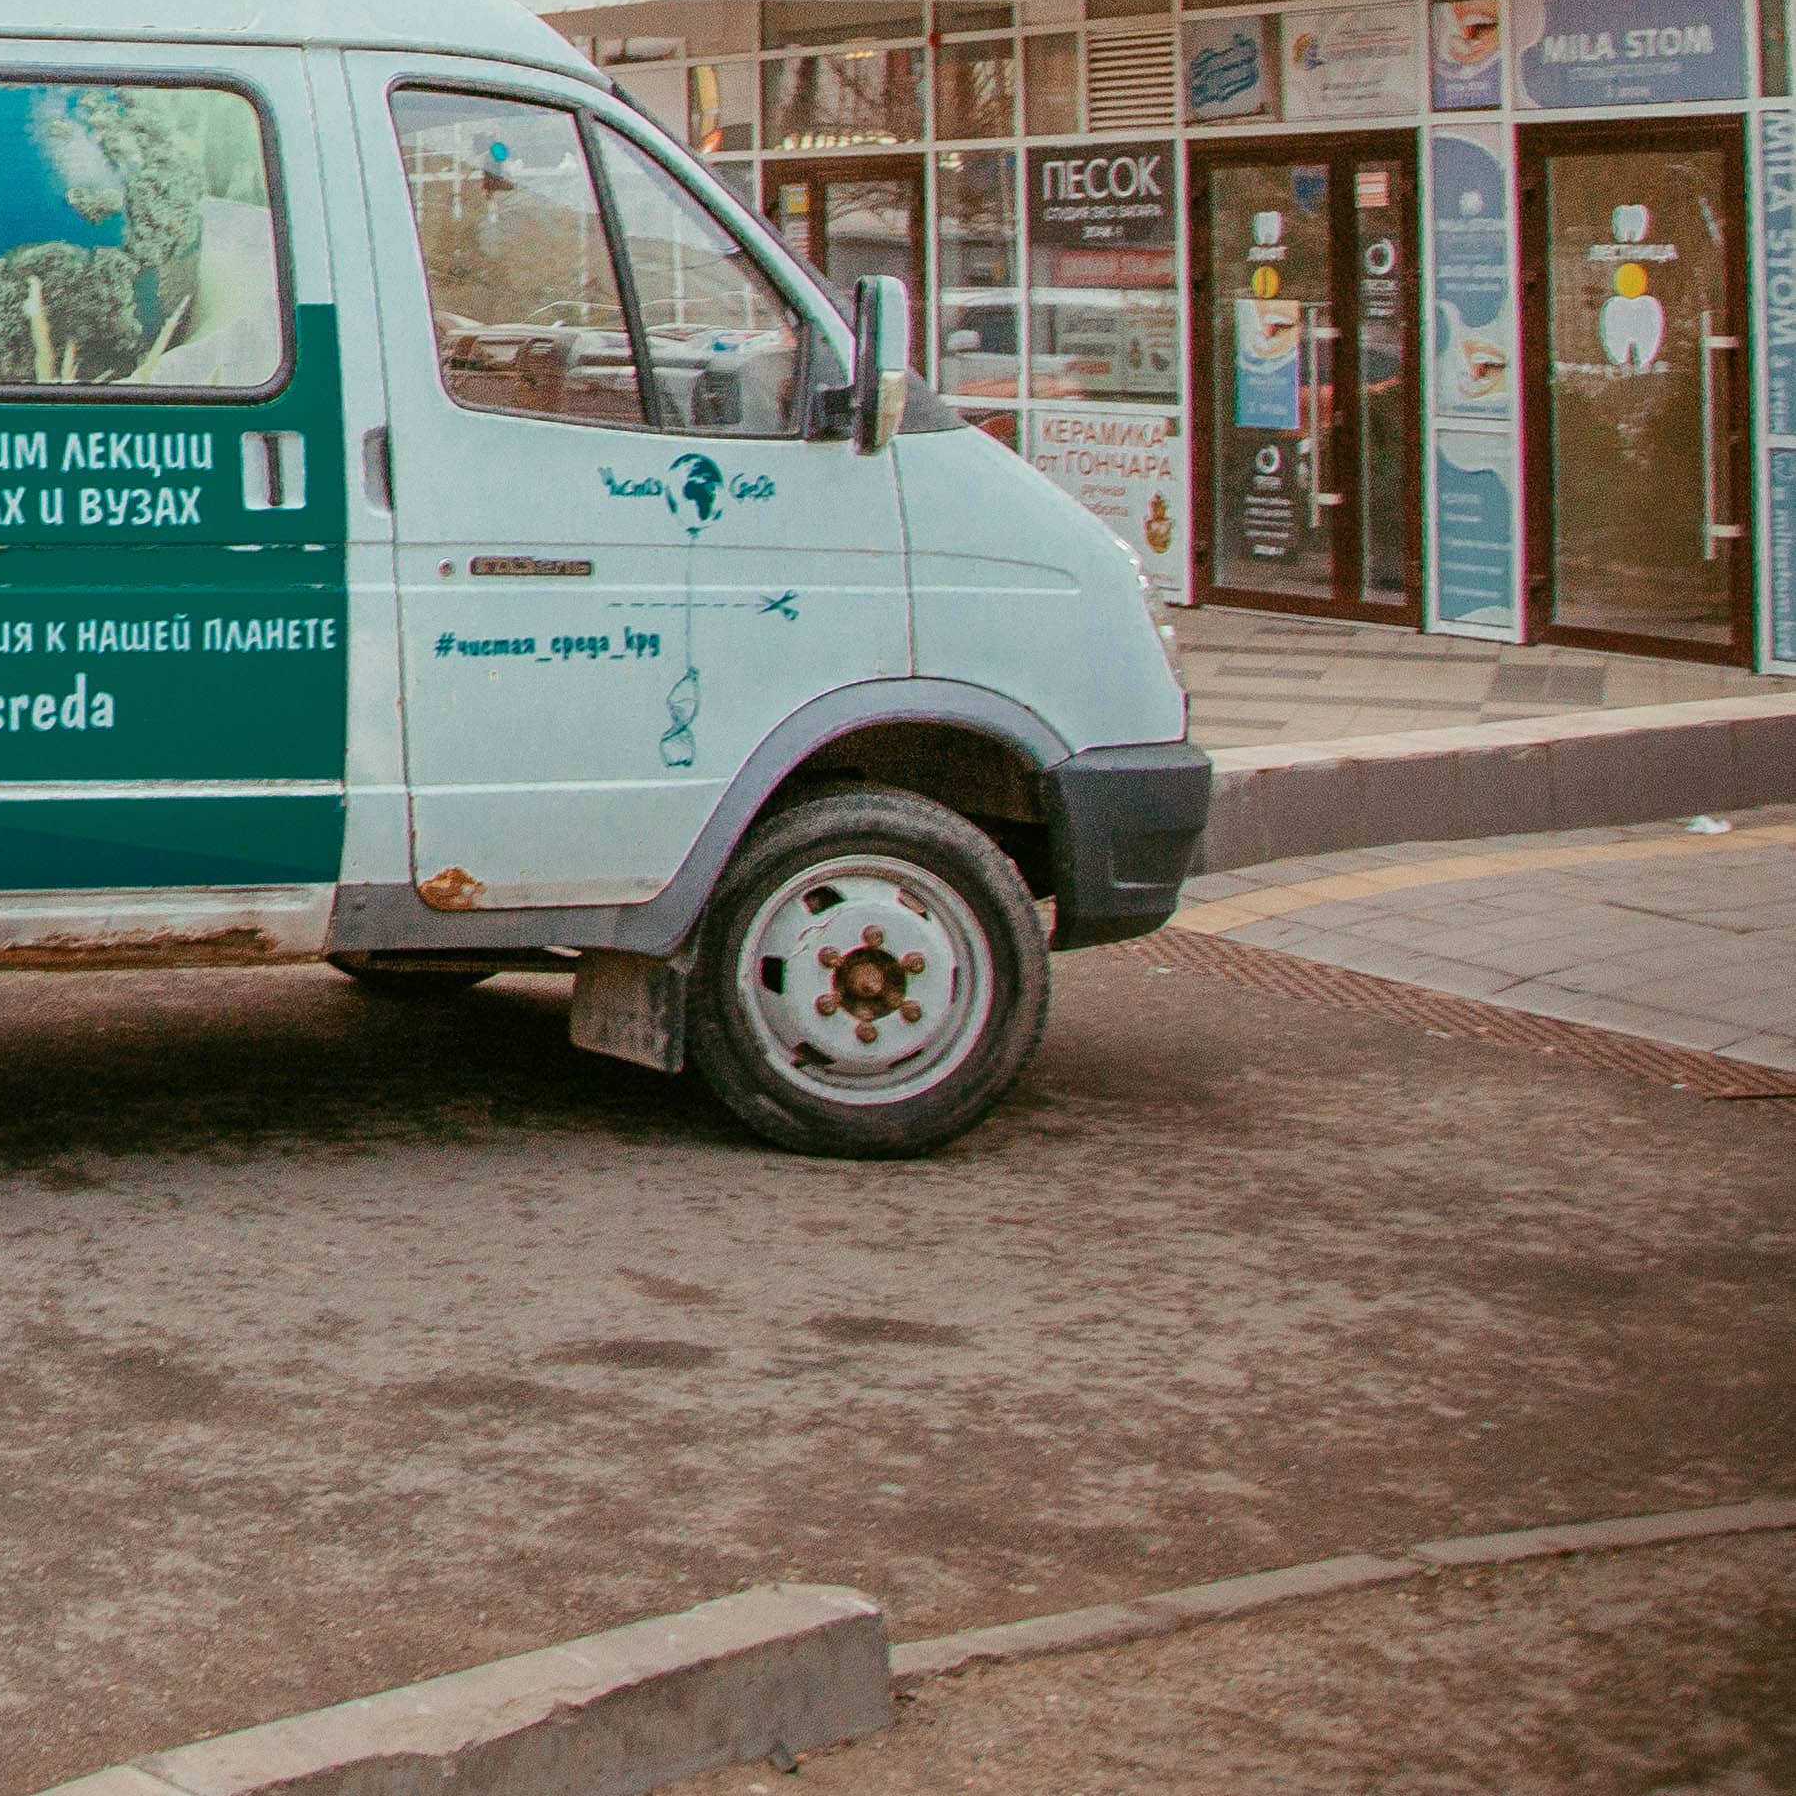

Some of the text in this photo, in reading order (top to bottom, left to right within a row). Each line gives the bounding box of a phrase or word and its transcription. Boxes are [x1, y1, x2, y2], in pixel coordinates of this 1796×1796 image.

[1542, 24, 1714, 64] MILA STOM
[1042, 155, 1163, 201] ПЕСОК
[1765, 113, 1796, 347] MILA STOM
[1041, 417, 1168, 448] КЕРАМИКА
[61, 431, 213, 478] ЛЕКЦИИ
[1035, 449, 1174, 480] от ГОНЧАРА
[40, 487, 63, 525] И
[80, 486, 202, 527] ВУЗАХ
[46, 622, 65, 653] К
[77, 614, 191, 653] НАШЕЙ
[204, 617, 336, 653] ПЛАНЕТЕ
